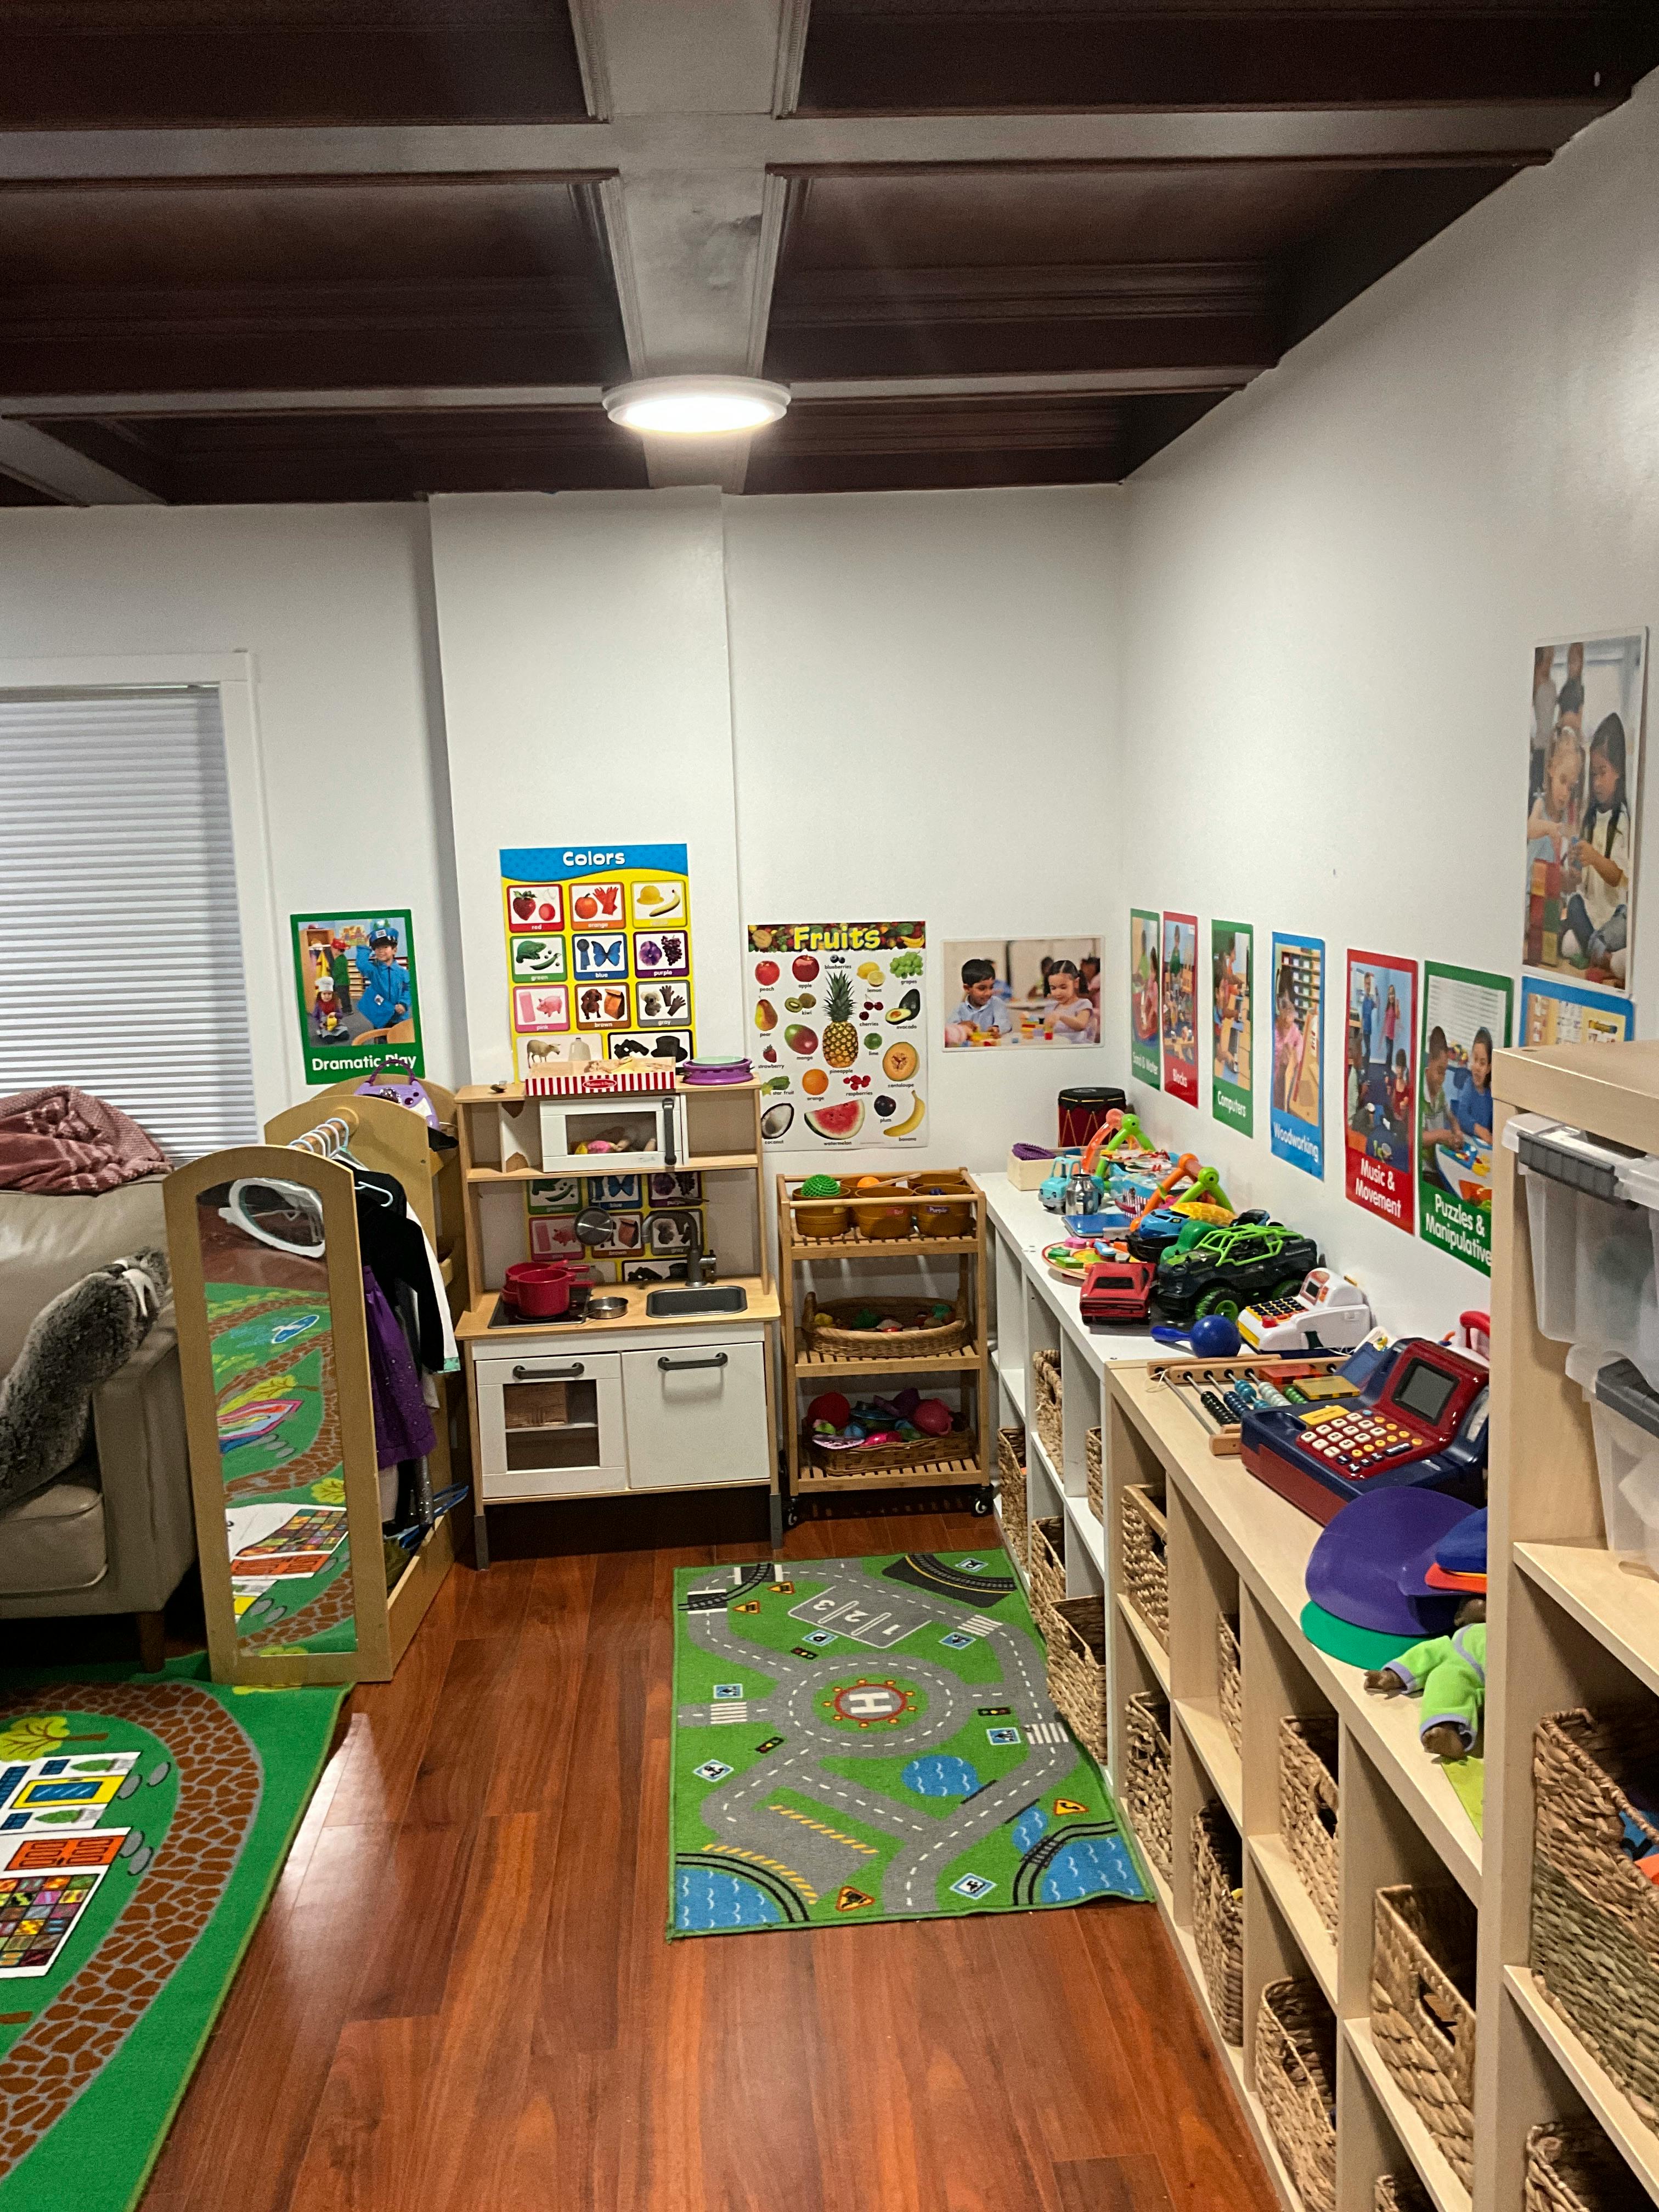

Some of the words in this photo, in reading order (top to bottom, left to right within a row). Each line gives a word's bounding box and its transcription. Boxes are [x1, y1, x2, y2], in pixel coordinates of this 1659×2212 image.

[563, 851, 625, 867] Colors
[793, 926, 881, 950] Fruits
[312, 1054, 382, 1071] Dramatic
[385, 1053, 417, 1069] Play
[1172, 1068, 1188, 1088] Blocks
[1217, 1090, 1246, 1118] Computers
[1273, 1121, 1319, 1163] Woodworking
[1361, 1158, 1385, 1187] Music
[1387, 1170, 1395, 1192] &
[1355, 1178, 1402, 1218] Movement
[1435, 1193, 1474, 1231] Puzzles
[1476, 1214, 1485, 1238] &
[813, 1599, 836, 1611] 3
[844, 1610, 870, 1623] 2
[882, 1624, 901, 1636] 1
[849, 1692, 893, 1714] H
